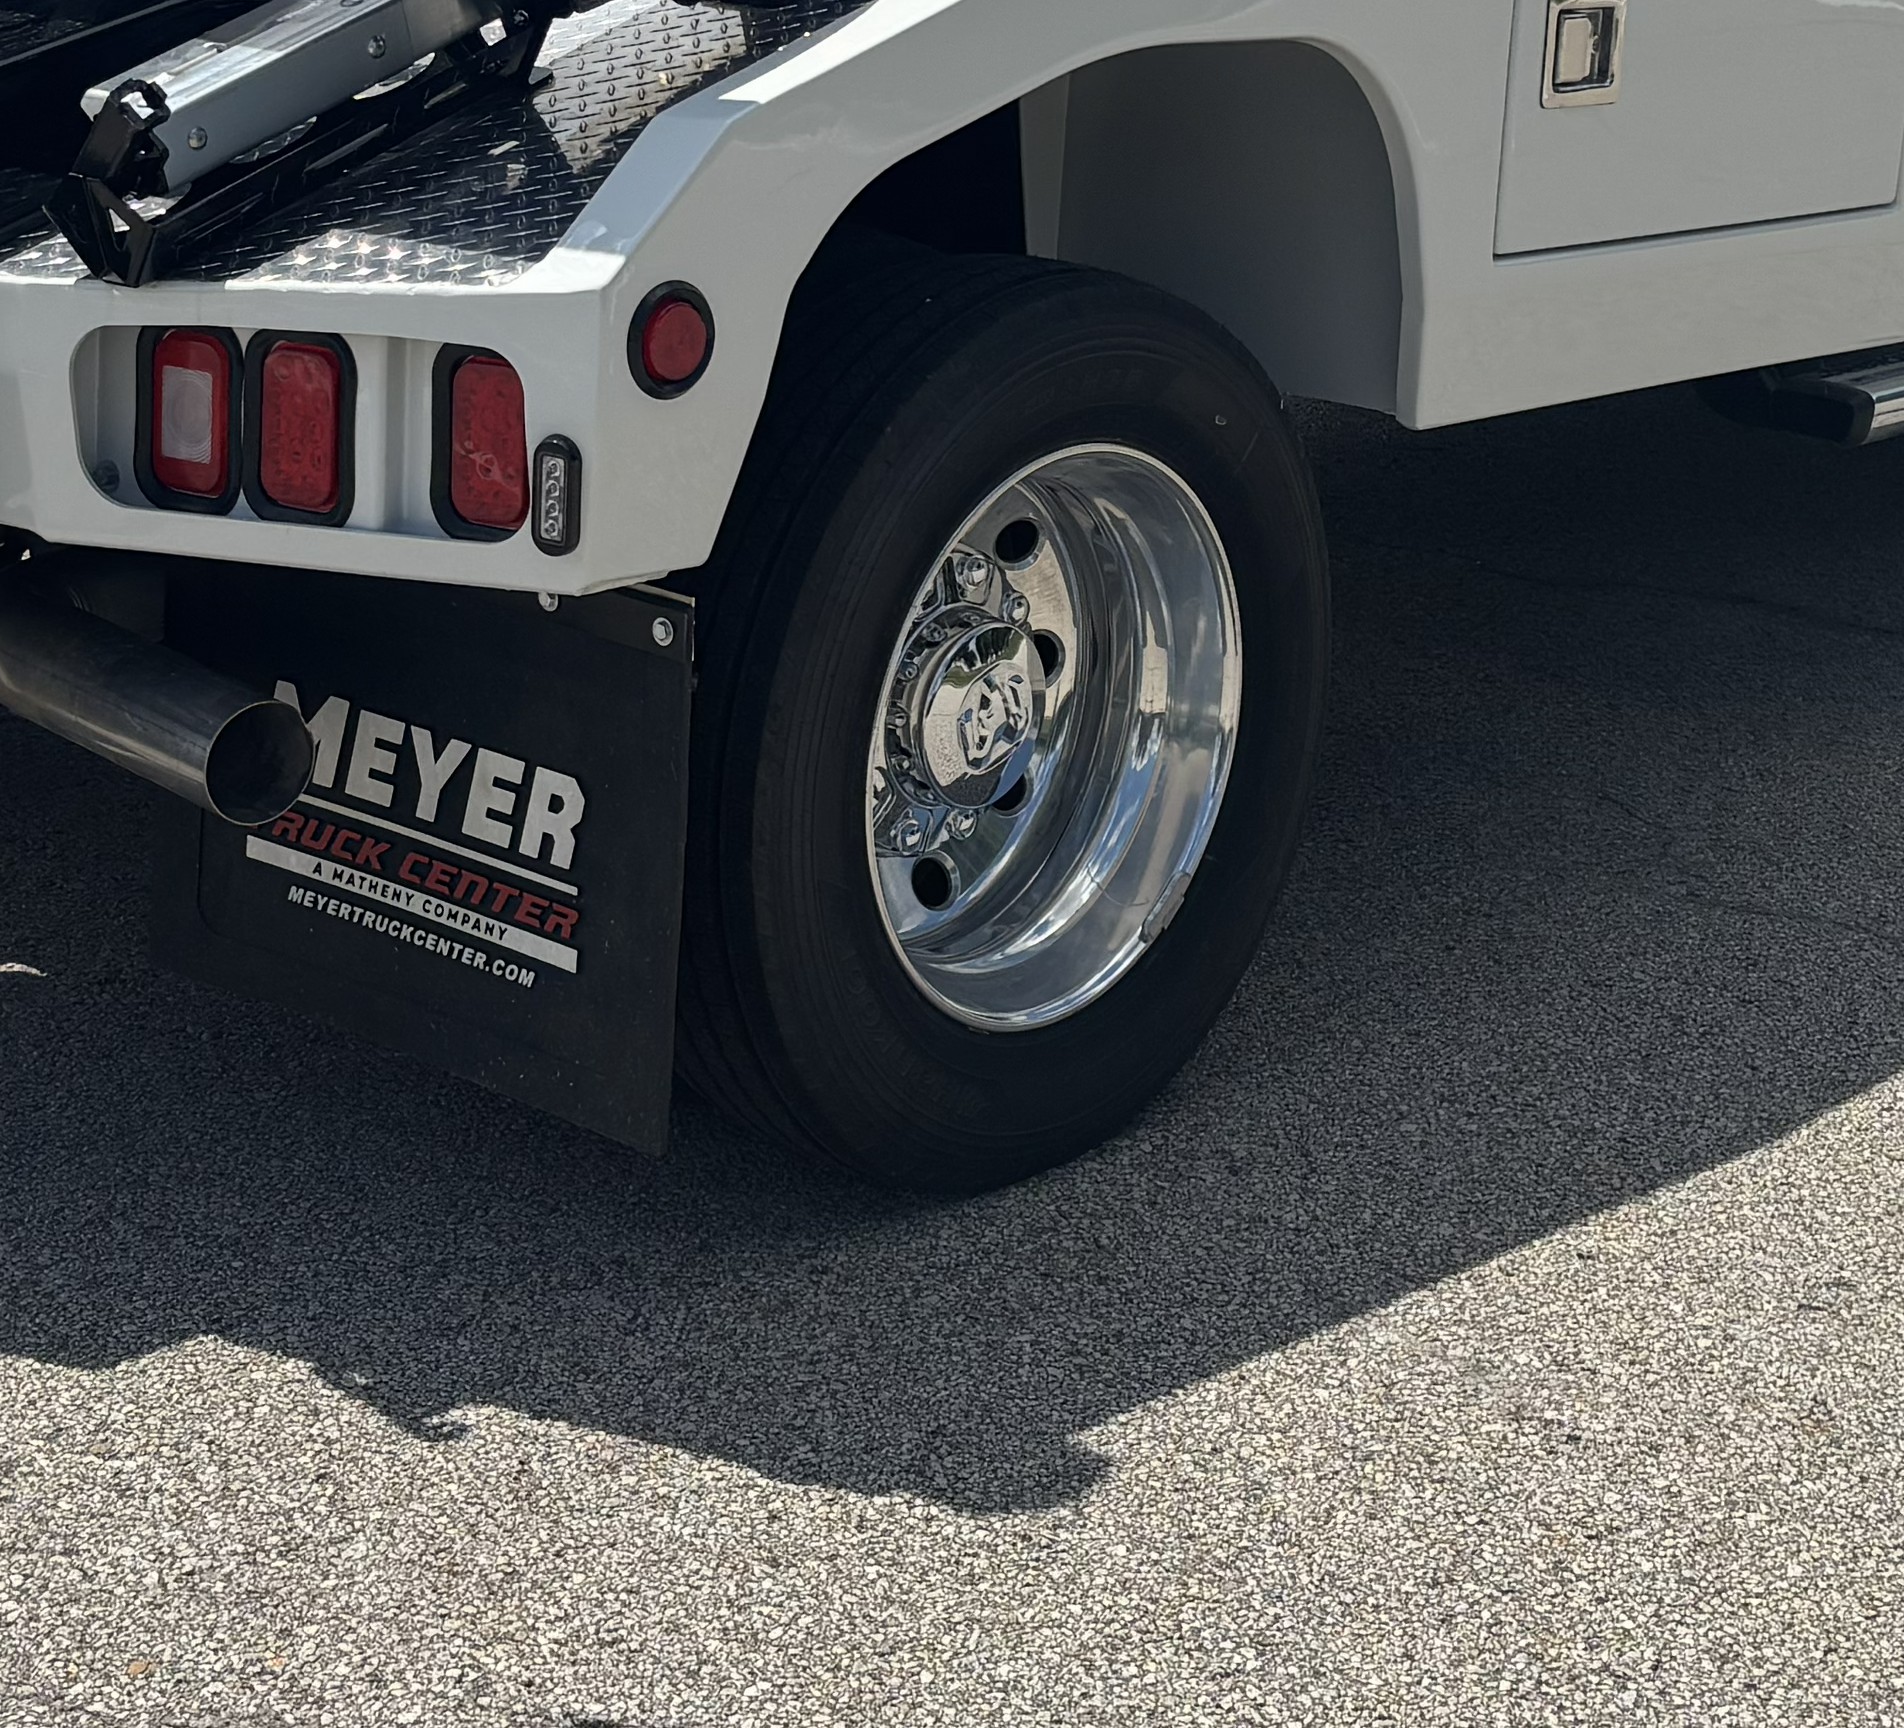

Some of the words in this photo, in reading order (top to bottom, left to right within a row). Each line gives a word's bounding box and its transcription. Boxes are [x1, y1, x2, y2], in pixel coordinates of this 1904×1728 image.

[273, 680, 586, 870] MEYER
[251, 811, 391, 871] RUCK
[399, 851, 580, 940] CENTER
[312, 862, 322, 877] A
[332, 867, 415, 907] MATHENY
[422, 899, 508, 941] COMPANY
[287, 885, 536, 988] MEYERTRUCKCENTER.COM
